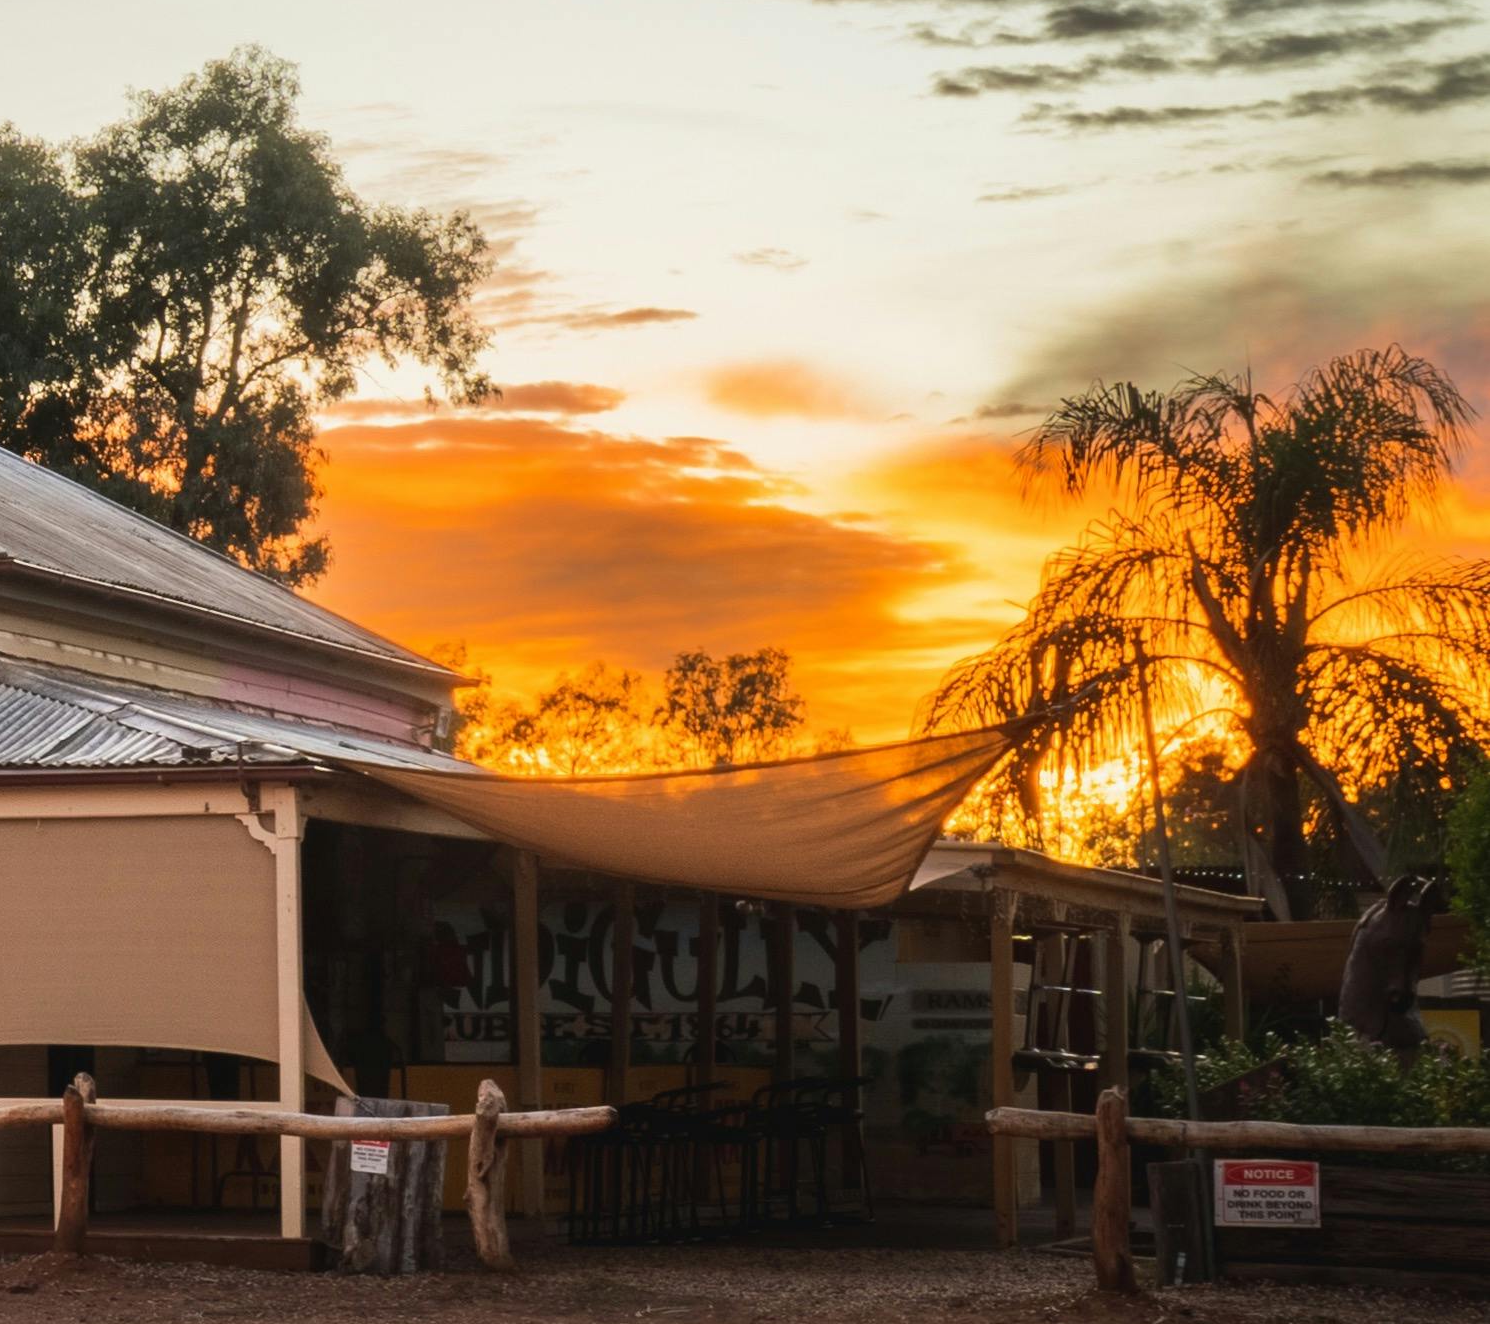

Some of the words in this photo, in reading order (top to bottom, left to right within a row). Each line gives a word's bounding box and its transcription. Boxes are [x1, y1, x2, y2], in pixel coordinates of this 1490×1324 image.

[1243, 1169, 1295, 1180] NOTICE
[1233, 1189, 1250, 1198] NO
[1253, 1189, 1285, 1198] FOOD
[1288, 1190, 1305, 1199] OR
[1227, 1200, 1262, 1209] DRINK
[1265, 1201, 1313, 1209] BEYOND
[1238, 1210, 1264, 1219] THIS
[1267, 1211, 1302, 1219] POINT
